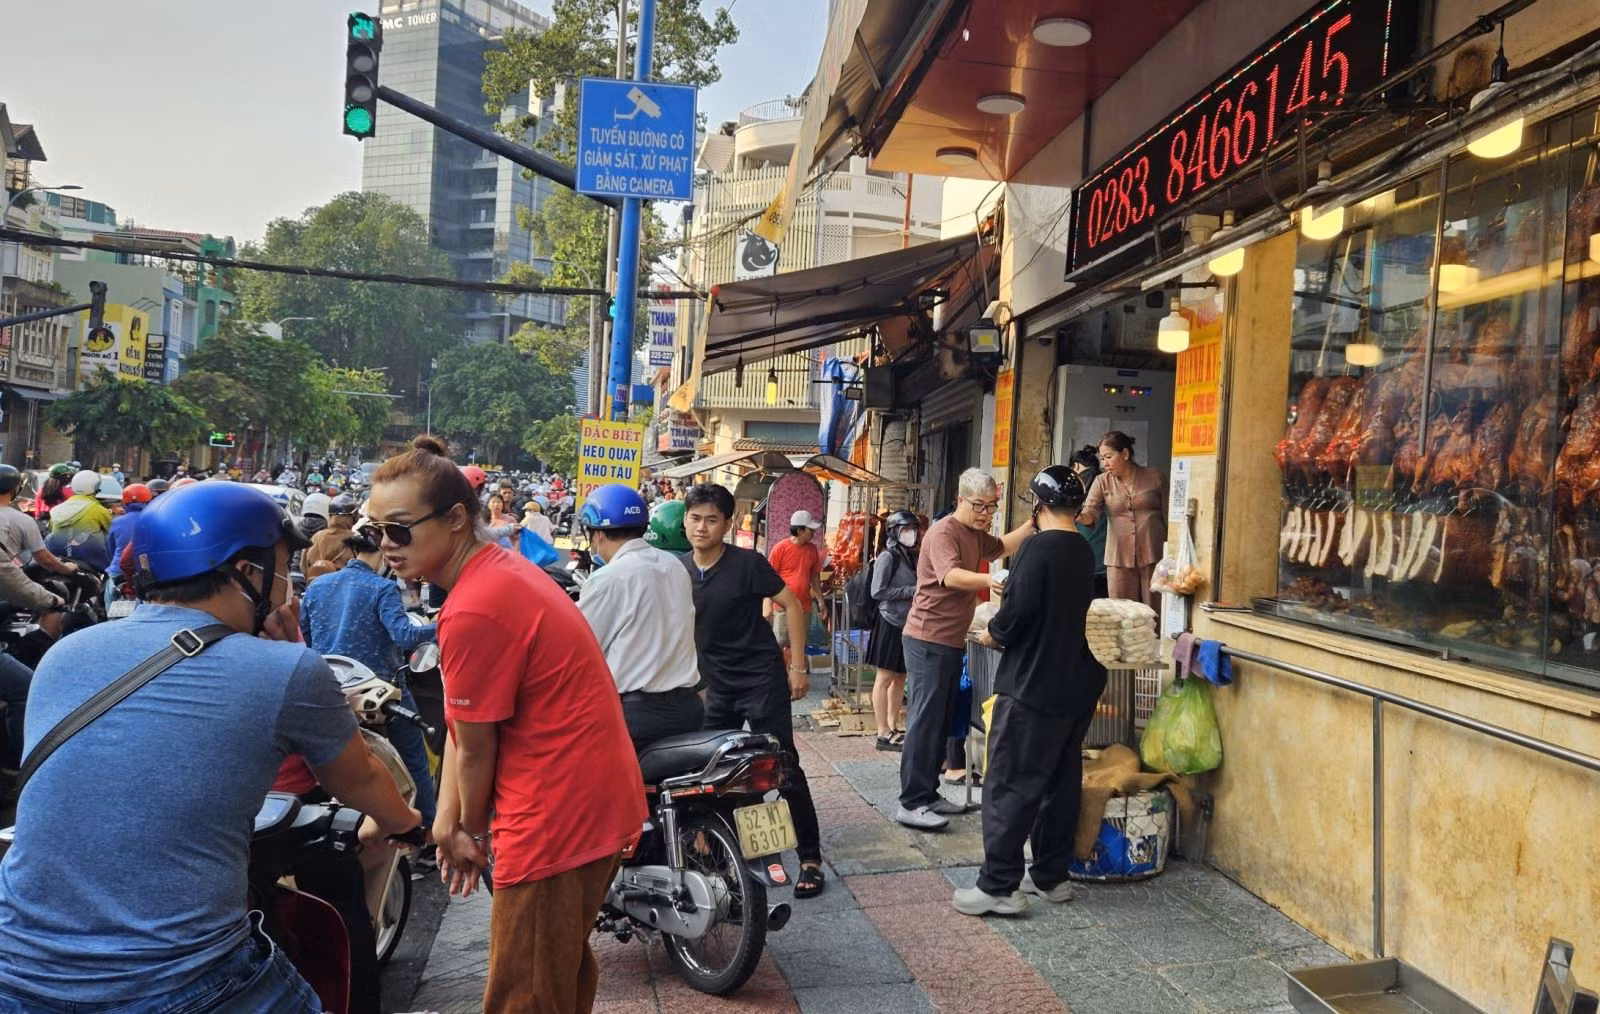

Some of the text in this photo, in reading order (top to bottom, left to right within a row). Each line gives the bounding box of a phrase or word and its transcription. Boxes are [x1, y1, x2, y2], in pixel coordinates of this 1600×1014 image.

[380, 12, 437, 30] MC TOWER
[590, 124, 685, 150] TUYẾN ĐƯỜNG CÓ
[584, 147, 612, 167] GIÁM
[641, 149, 657, 170] XỬ
[659, 155, 689, 176] PHẠT
[595, 168, 674, 195] BẰNG CAMERA
[1088, 156, 1155, 249] 0283.
[650, 311, 676, 327] THANH
[651, 328, 673, 347] XUÂN
[583, 425, 641, 444] ĐẶC BIỆT
[670, 428, 699, 438] THANH
[672, 437, 694, 449] XUÂN
[583, 445, 638, 462] HEO QUAY
[584, 463, 607, 477] KHO
[624, 506, 641, 515] ACB
[749, 826, 788, 853] 6307
